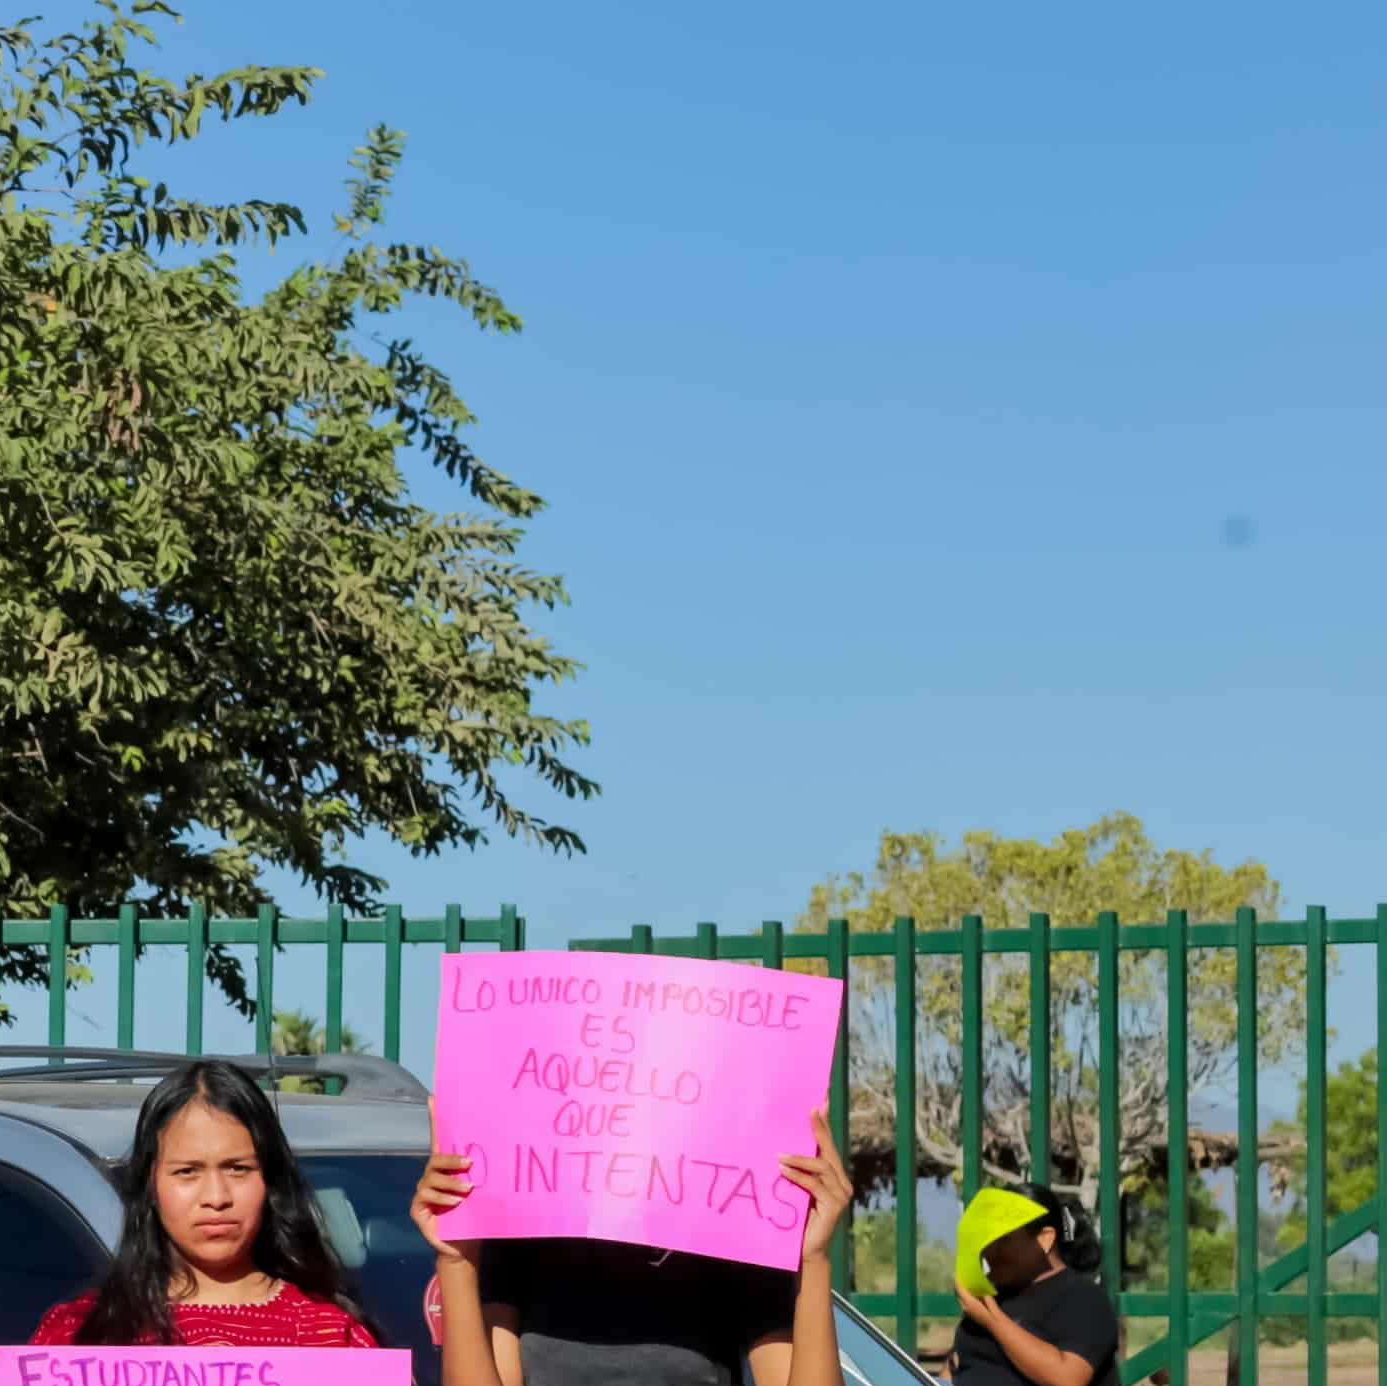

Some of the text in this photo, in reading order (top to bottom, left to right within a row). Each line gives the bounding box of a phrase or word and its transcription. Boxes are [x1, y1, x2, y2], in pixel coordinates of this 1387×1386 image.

[452, 967, 810, 1031] LO UNICO IMPOSIBLE
[580, 1012, 636, 1055] ES
[512, 1046, 702, 1105] AQUELLO
[552, 1099, 636, 1138] QUE
[514, 1142, 801, 1232] INTENTAS
